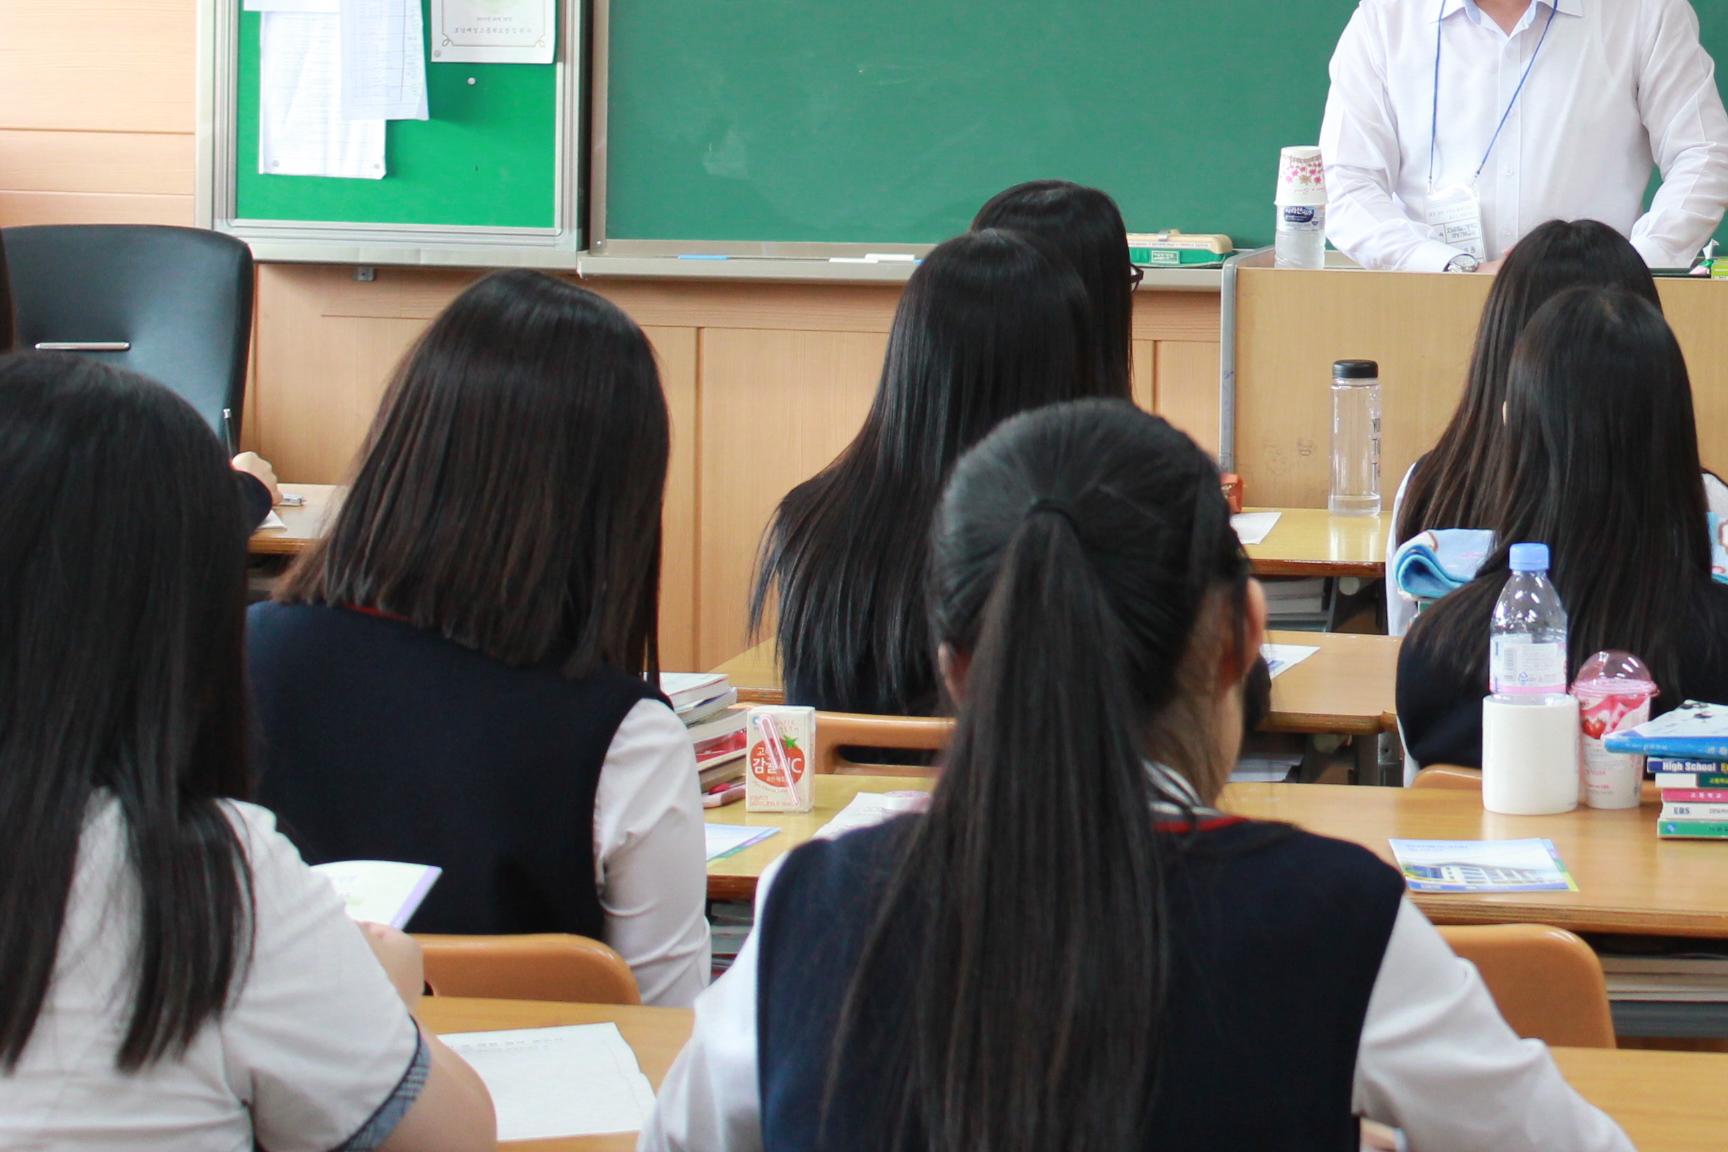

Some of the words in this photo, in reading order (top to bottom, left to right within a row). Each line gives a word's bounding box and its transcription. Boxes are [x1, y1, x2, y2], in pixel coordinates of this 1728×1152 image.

[1662, 761, 1683, 772] High
[1685, 761, 1717, 772] School
[1673, 807, 1690, 815] EBS
